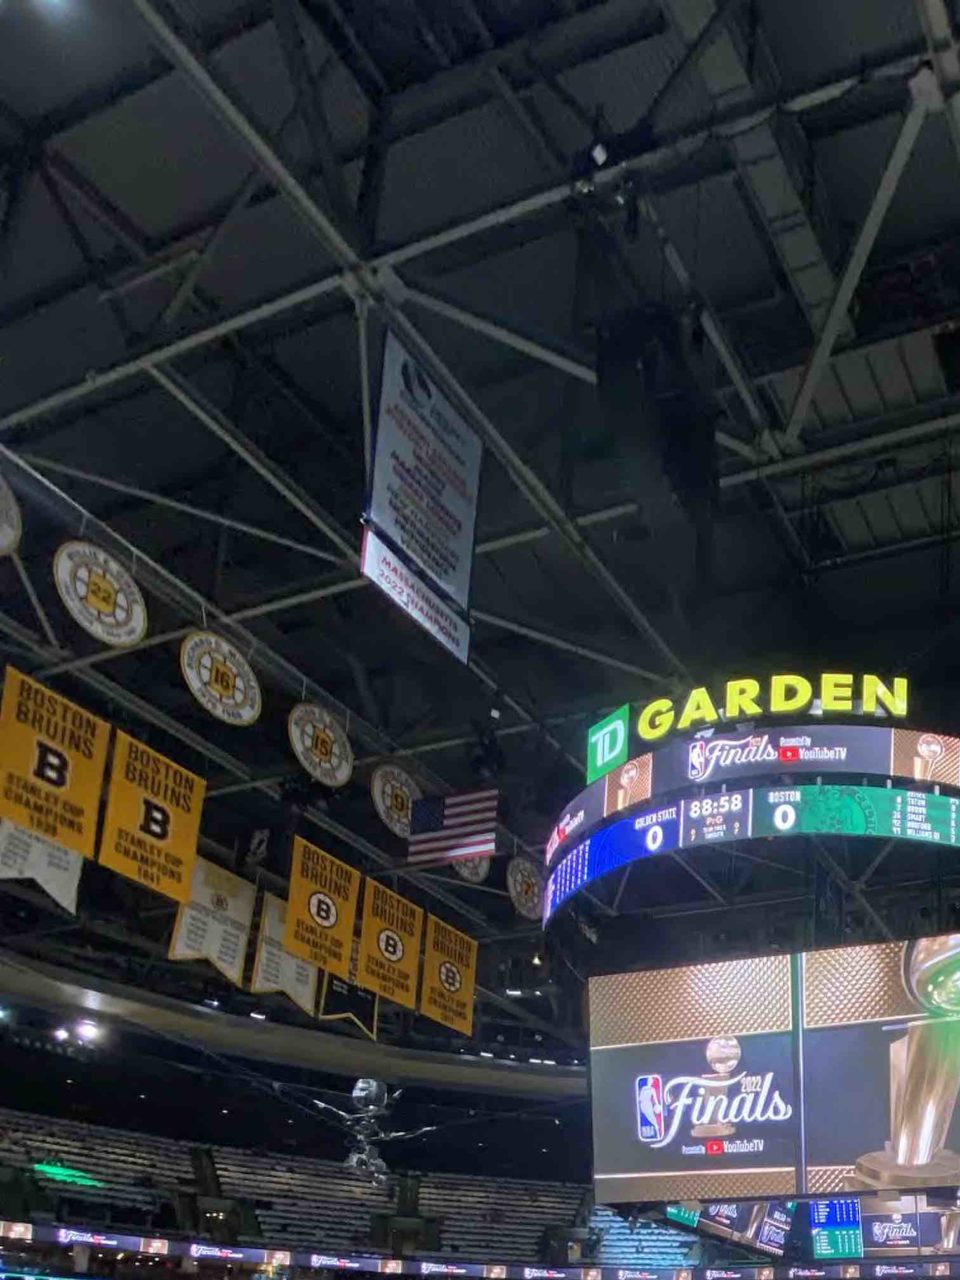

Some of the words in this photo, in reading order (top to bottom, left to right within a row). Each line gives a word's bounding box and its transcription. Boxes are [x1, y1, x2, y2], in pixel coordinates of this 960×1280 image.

[91, 581, 113, 604] 22
[379, 569, 404, 595] 2022
[381, 557, 458, 632] MASSACHUSETTS
[214, 667, 231, 689] 16
[19, 679, 97, 739] BOSTON
[591, 719, 625, 768] TD
[637, 672, 909, 740] GARDEN
[15, 703, 93, 760] BRUINS
[314, 733, 329, 756] 15
[33, 740, 69, 788] B
[127, 741, 195, 793] BOSTON
[696, 734, 778, 782] Finals
[7, 772, 60, 808] STANLEY
[62, 798, 84, 817] CUP
[124, 763, 192, 814] BRUINS
[768, 791, 801, 803] BOSTON
[4, 786, 83, 834] CHAMPIONS
[139, 797, 170, 841] B
[657, 807, 677, 824] STATE
[690, 794, 743, 819] 88:58
[773, 804, 797, 831] 0
[907, 814, 925, 822] SMART
[117, 828, 159, 858] STANLEY
[164, 851, 183, 868] CUP
[646, 824, 663, 851] 0
[115, 842, 182, 884] CHAMPIONS
[303, 845, 352, 884] BOSTON
[301, 863, 349, 901] BRUINS
[316, 899, 330, 920] B
[372, 900, 414, 937] BRUINS
[374, 884, 416, 921] BOSTON
[294, 929, 342, 962] CHAMPIONS
[296, 918, 329, 941] STANLEY
[384, 935, 398, 955] B
[434, 920, 471, 954] BOSTON
[432, 935, 470, 970] BRUINS
[443, 967, 457, 987] B
[741, 1076, 762, 1092] 2022
[650, 1071, 793, 1148] Finals
[877, 1221, 917, 1242] Finals
